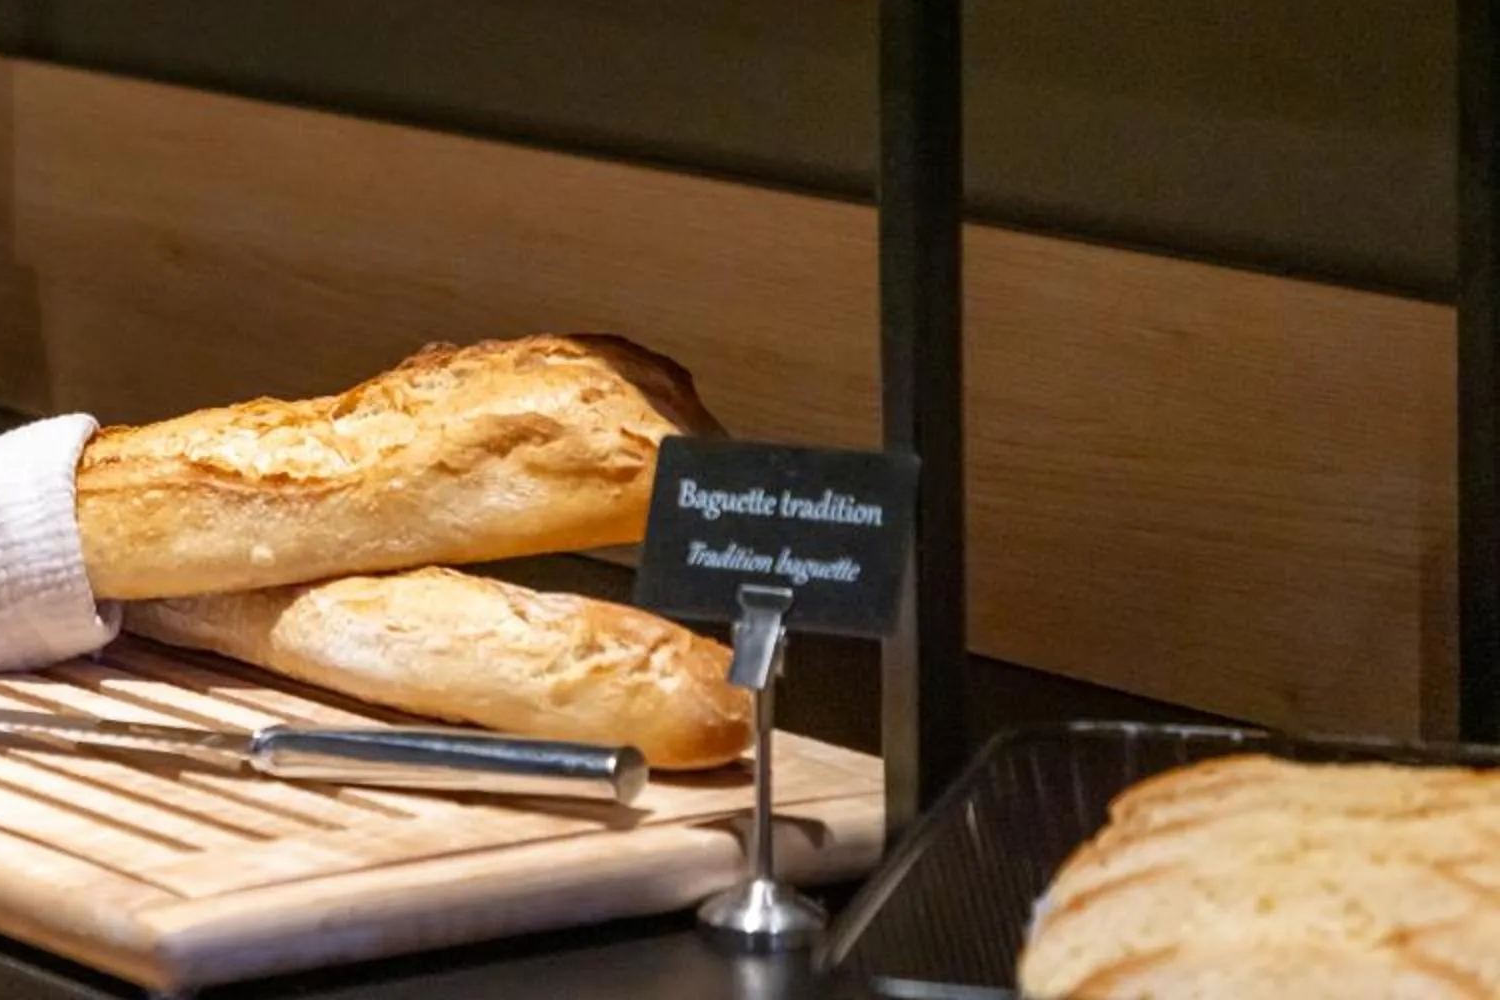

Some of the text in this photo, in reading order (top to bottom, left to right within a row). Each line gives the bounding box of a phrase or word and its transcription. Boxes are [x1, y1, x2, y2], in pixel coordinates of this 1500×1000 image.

[678, 478, 883, 526] Baguette tradition
[687, 541, 860, 585] Tradition baguette
